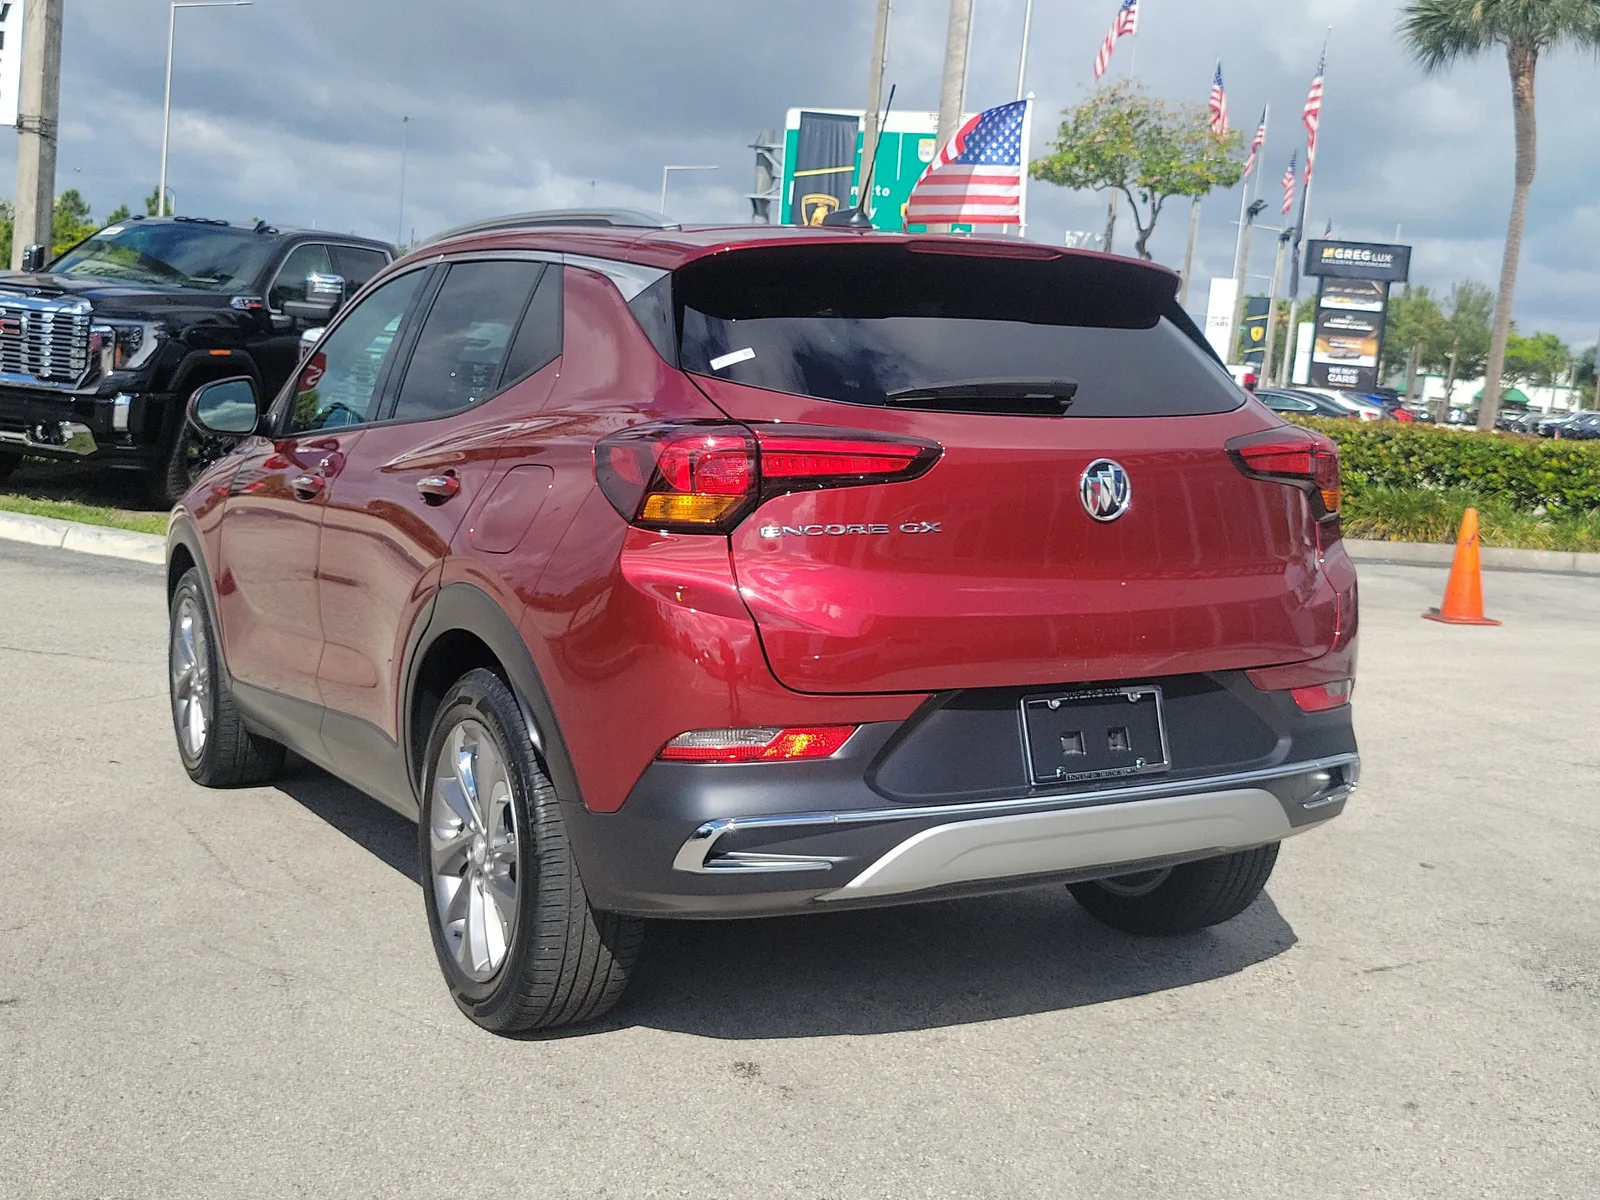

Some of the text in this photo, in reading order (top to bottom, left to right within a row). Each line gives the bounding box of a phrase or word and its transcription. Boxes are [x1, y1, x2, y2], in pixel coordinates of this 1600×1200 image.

[1334, 247, 1393, 263] GREG LUX
[1328, 366, 1341, 374] WE
[1327, 373, 1359, 384] CARS
[760, 521, 942, 538] ENCORE GX
